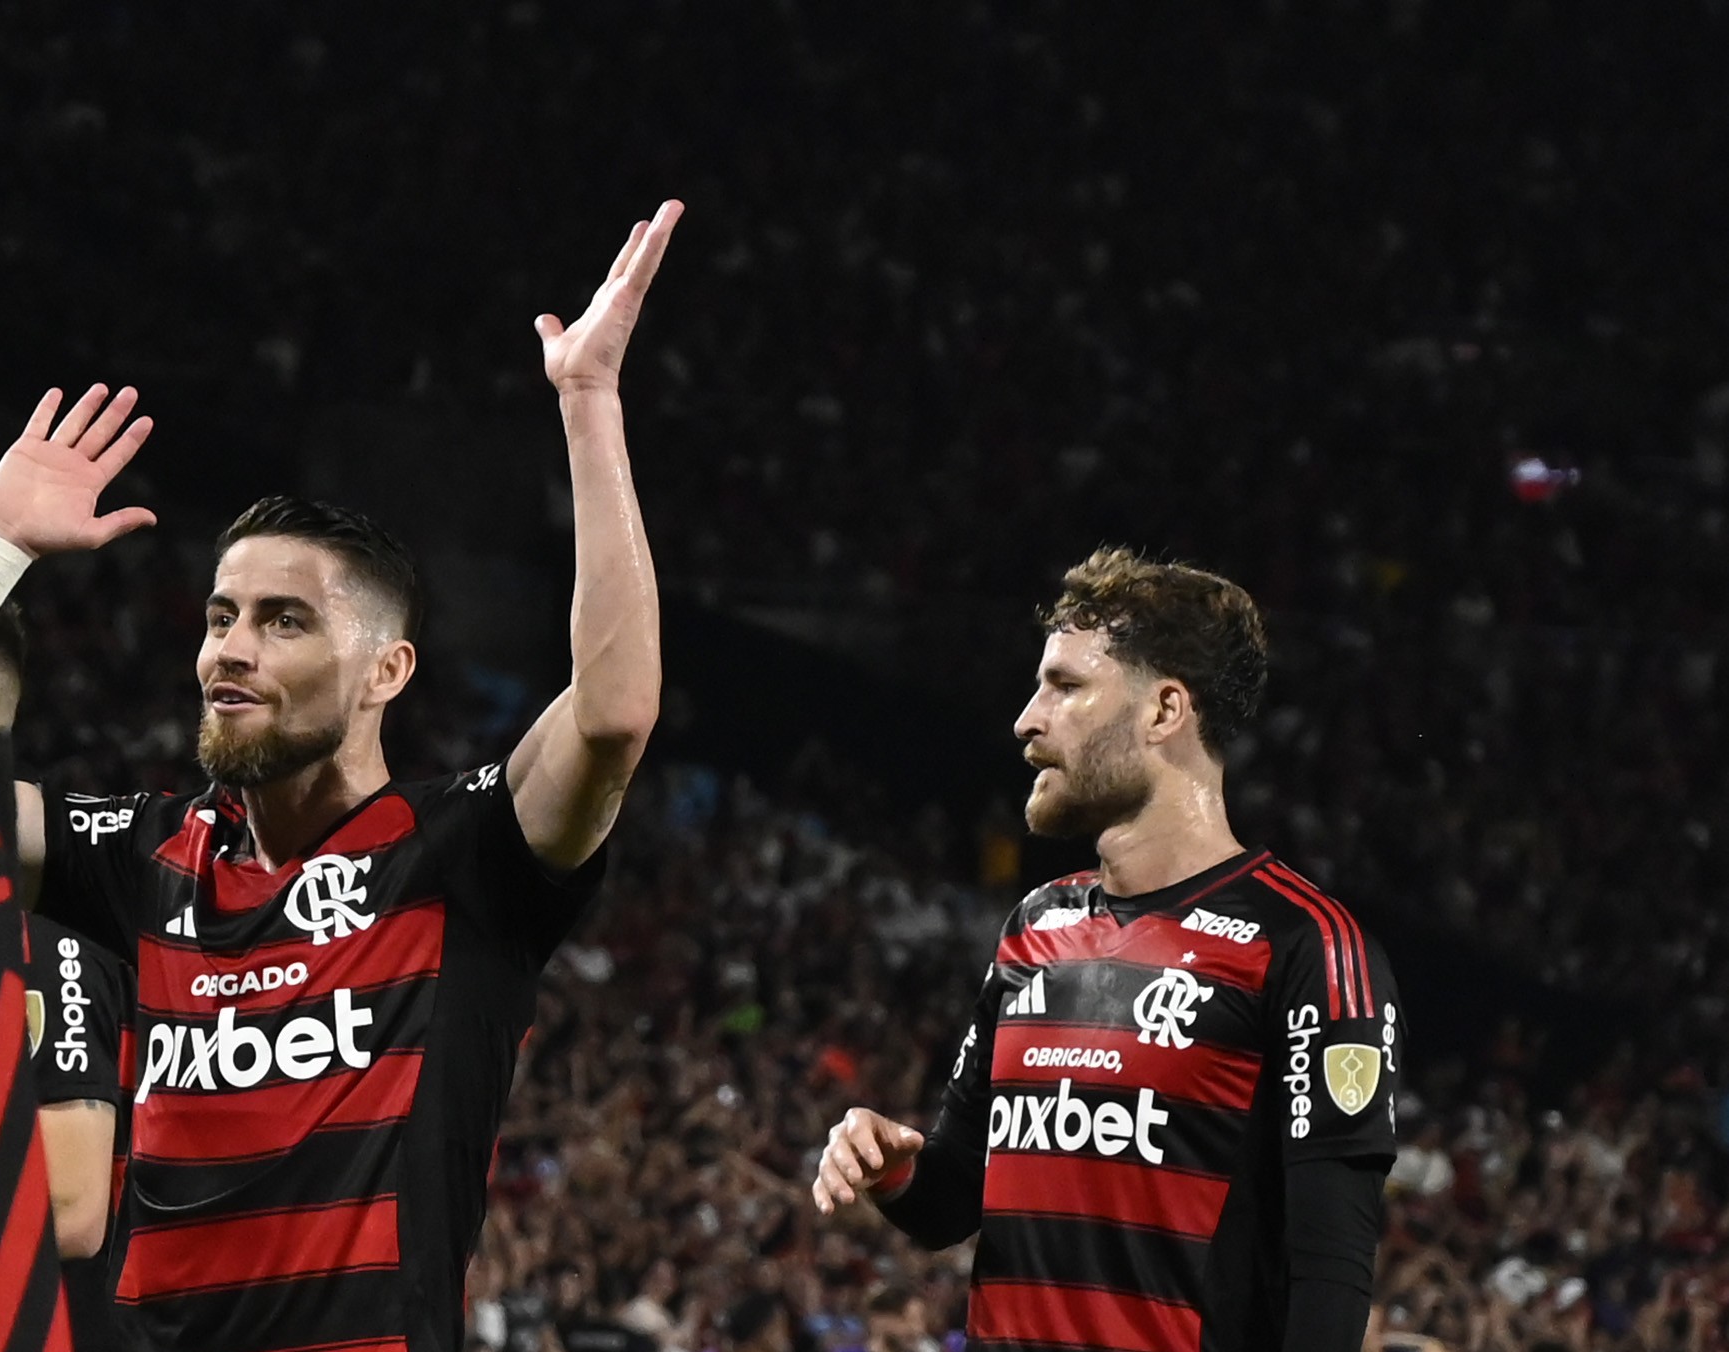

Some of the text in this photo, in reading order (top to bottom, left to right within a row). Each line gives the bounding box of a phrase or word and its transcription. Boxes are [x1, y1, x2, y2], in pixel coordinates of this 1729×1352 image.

[1200, 916, 1260, 944] BRB
[54, 937, 91, 1072] Shopee
[134, 988, 374, 1104] pixbet
[1023, 1047, 1123, 1074] OBRIGADO,
[1283, 1004, 1321, 1139] Shopee
[985, 1078, 1169, 1168] pixbet
